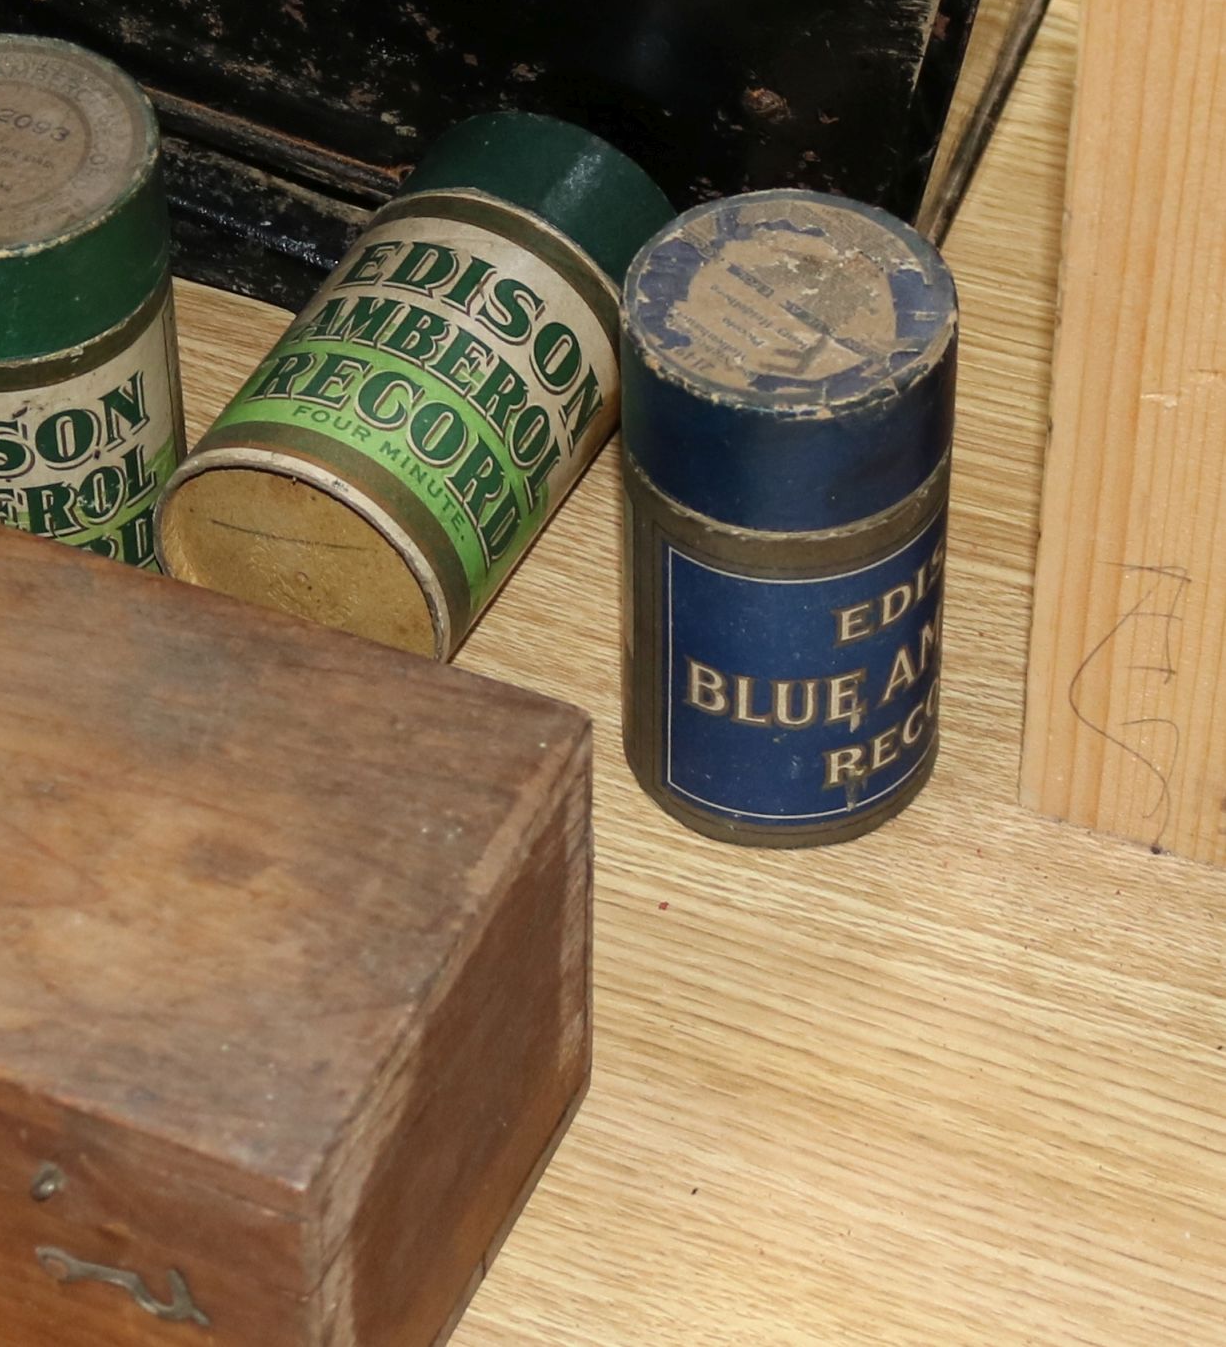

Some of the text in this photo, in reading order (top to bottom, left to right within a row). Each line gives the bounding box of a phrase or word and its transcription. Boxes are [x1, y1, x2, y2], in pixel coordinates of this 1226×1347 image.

[291, 295, 561, 516] AMBEROL
[291, 404, 373, 443] FOUR
[332, 240, 604, 458] EDISON
[243, 351, 524, 570] RECORD
[686, 658, 866, 728] BLUE
